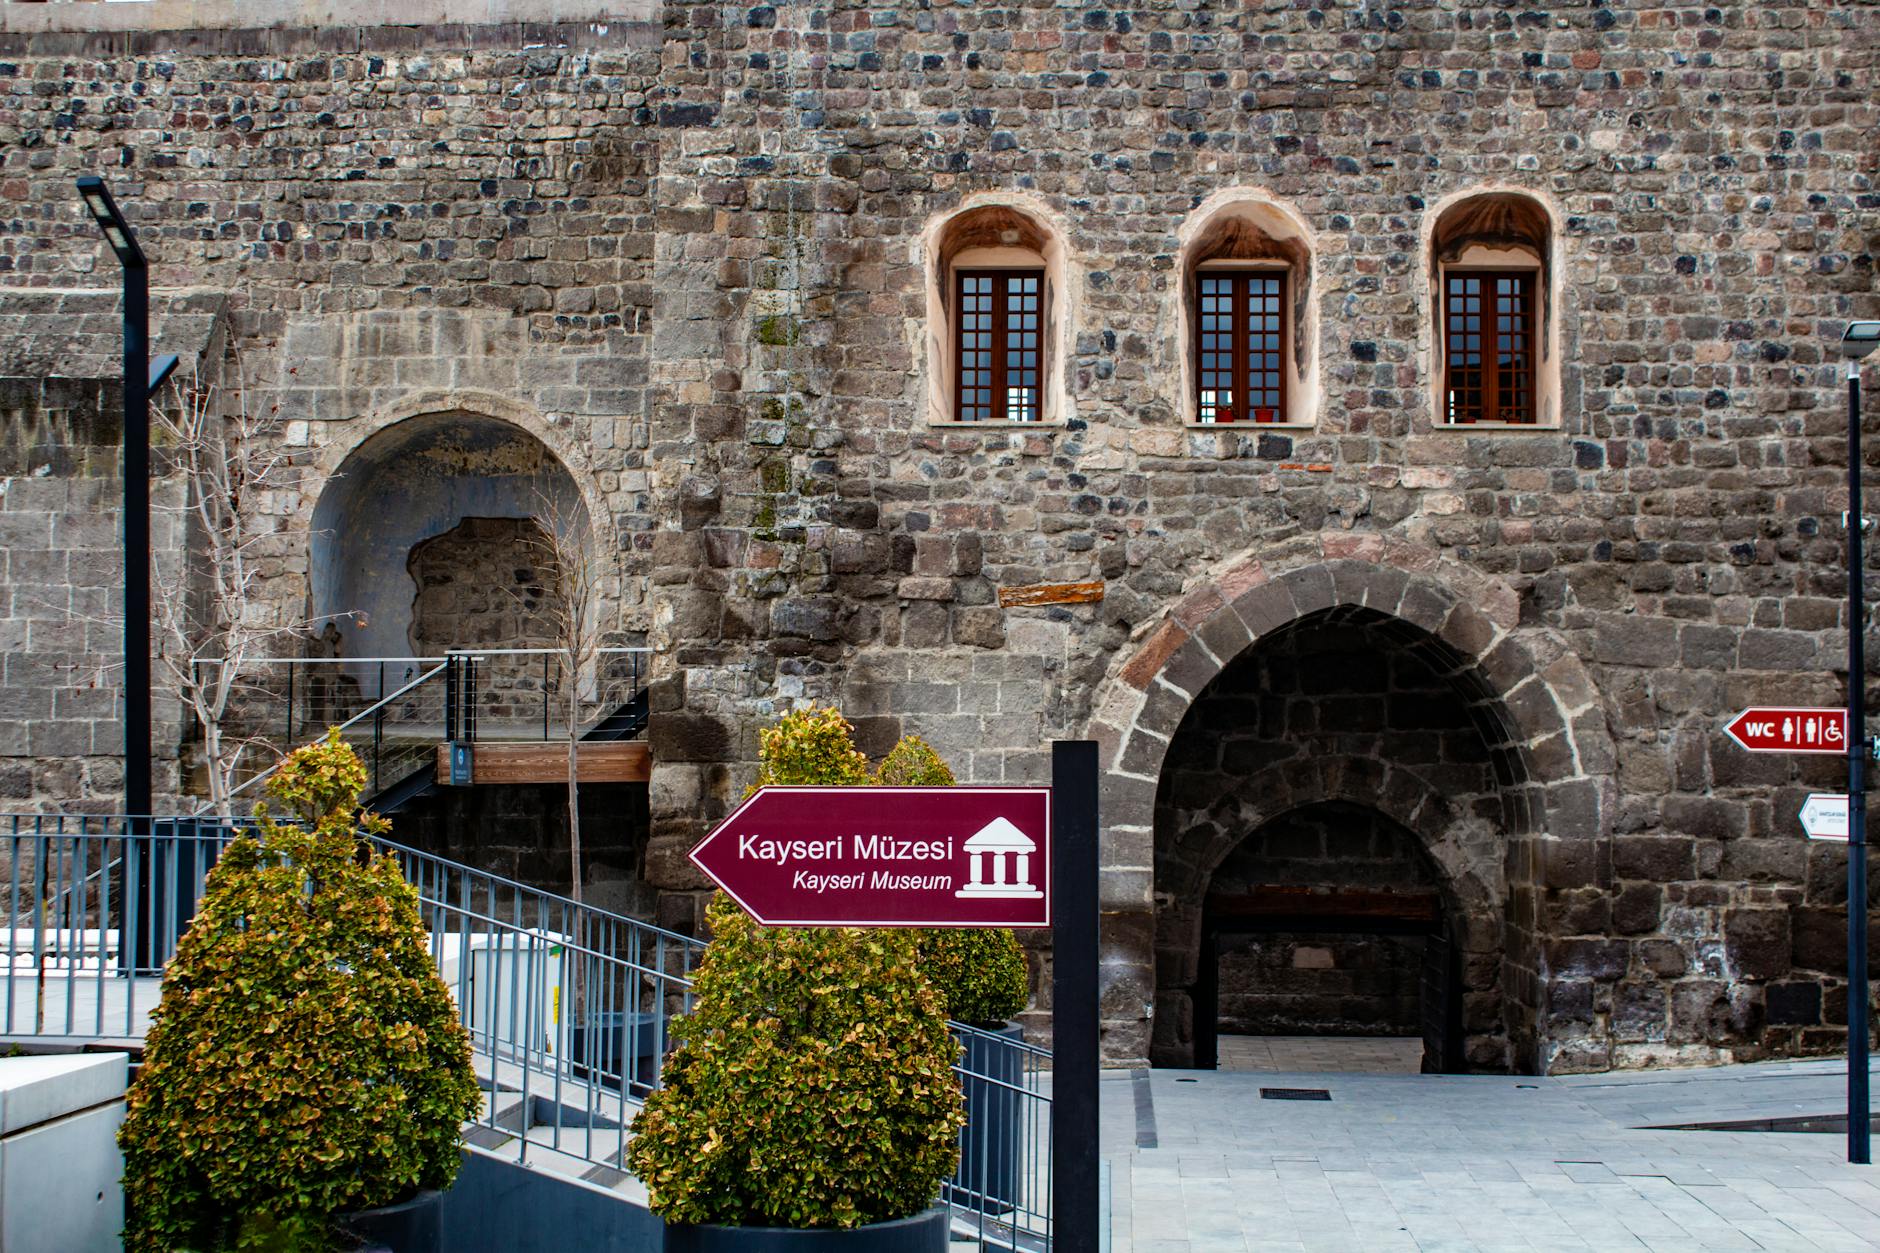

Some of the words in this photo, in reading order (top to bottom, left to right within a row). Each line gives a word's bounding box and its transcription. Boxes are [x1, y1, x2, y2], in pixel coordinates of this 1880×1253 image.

[1745, 722, 1775, 737] WC
[739, 834, 843, 866] Kayseri
[854, 834, 953, 861] Müzesi
[792, 870, 866, 894] Kayseri
[870, 870, 952, 890] Museum
